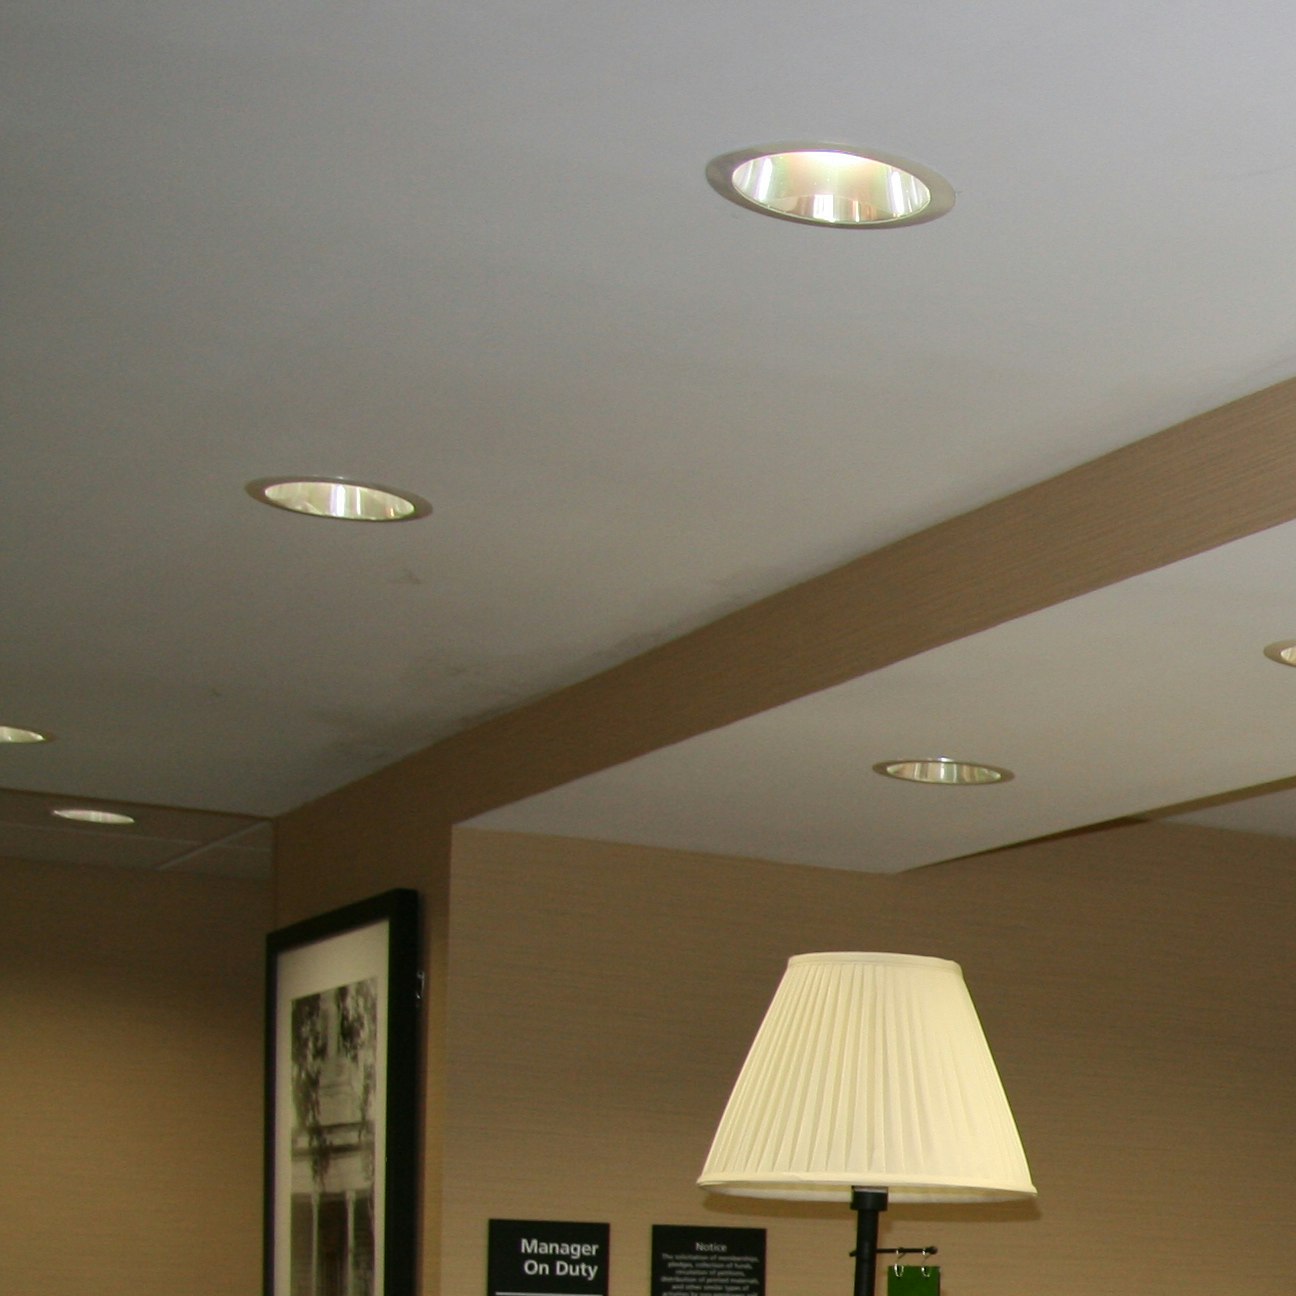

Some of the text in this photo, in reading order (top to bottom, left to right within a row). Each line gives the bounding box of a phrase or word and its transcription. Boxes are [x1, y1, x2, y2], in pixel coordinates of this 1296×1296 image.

[520, 1238, 600, 1260] Manager
[695, 1242, 727, 1252] Notice
[524, 1259, 599, 1281] On Duty
